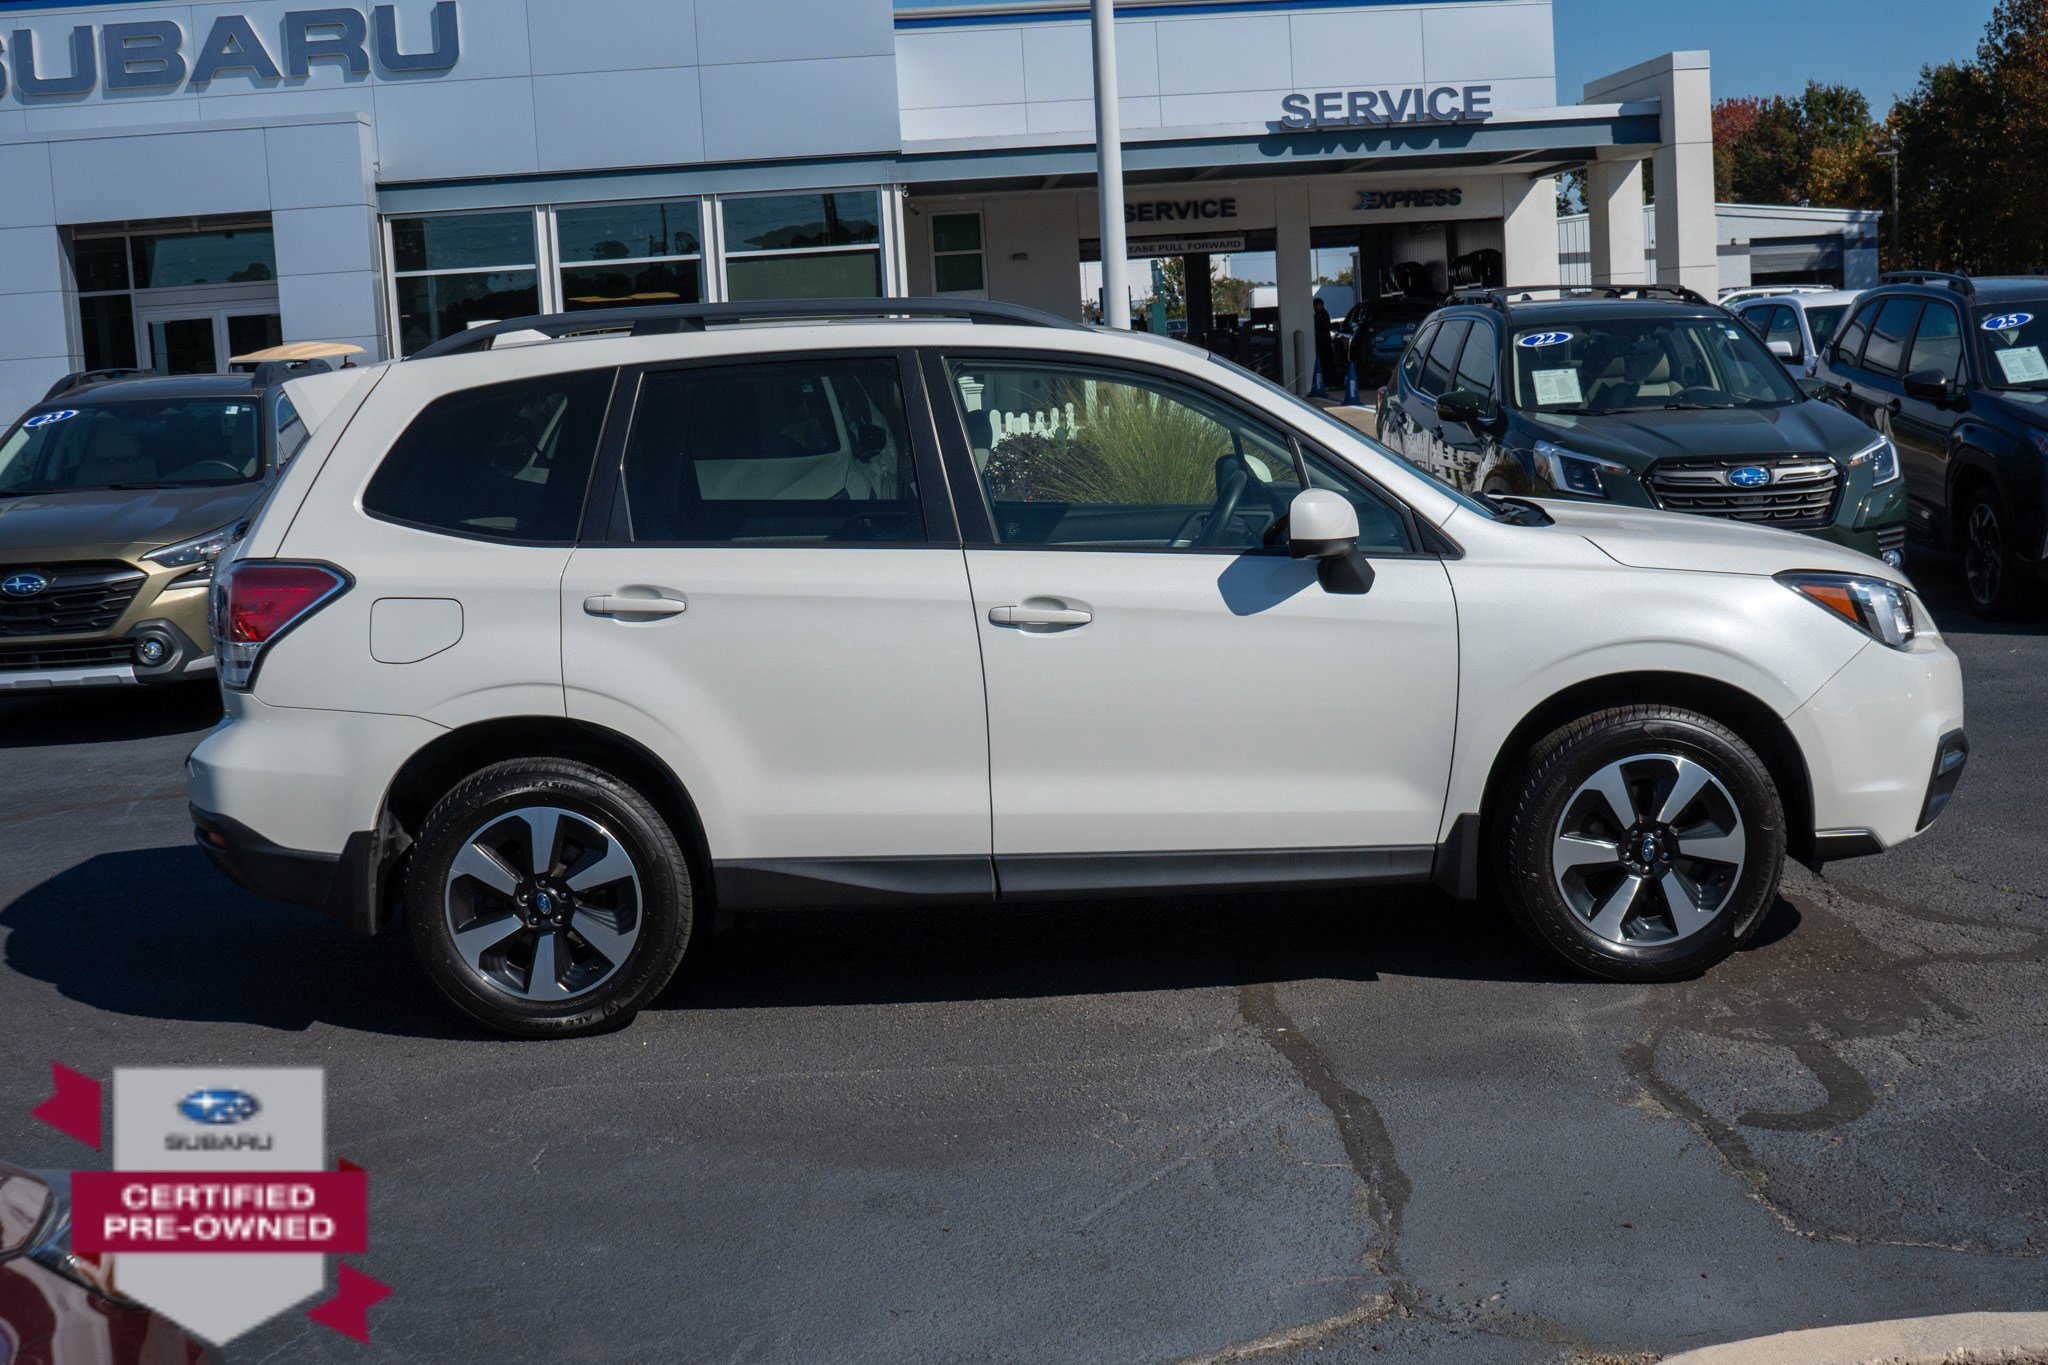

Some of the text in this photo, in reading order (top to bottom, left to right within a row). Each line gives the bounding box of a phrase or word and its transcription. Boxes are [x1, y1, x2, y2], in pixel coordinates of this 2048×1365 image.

[0, 1, 459, 97] UBARU
[1281, 85, 1493, 129] SERVICE
[1352, 187, 1462, 210] EXPRESS
[1124, 199, 1237, 224] SERVICE
[1128, 240, 1242, 253] EASE PULL FORWARD
[1996, 314, 2018, 329] 25
[1533, 332, 1556, 346] 22
